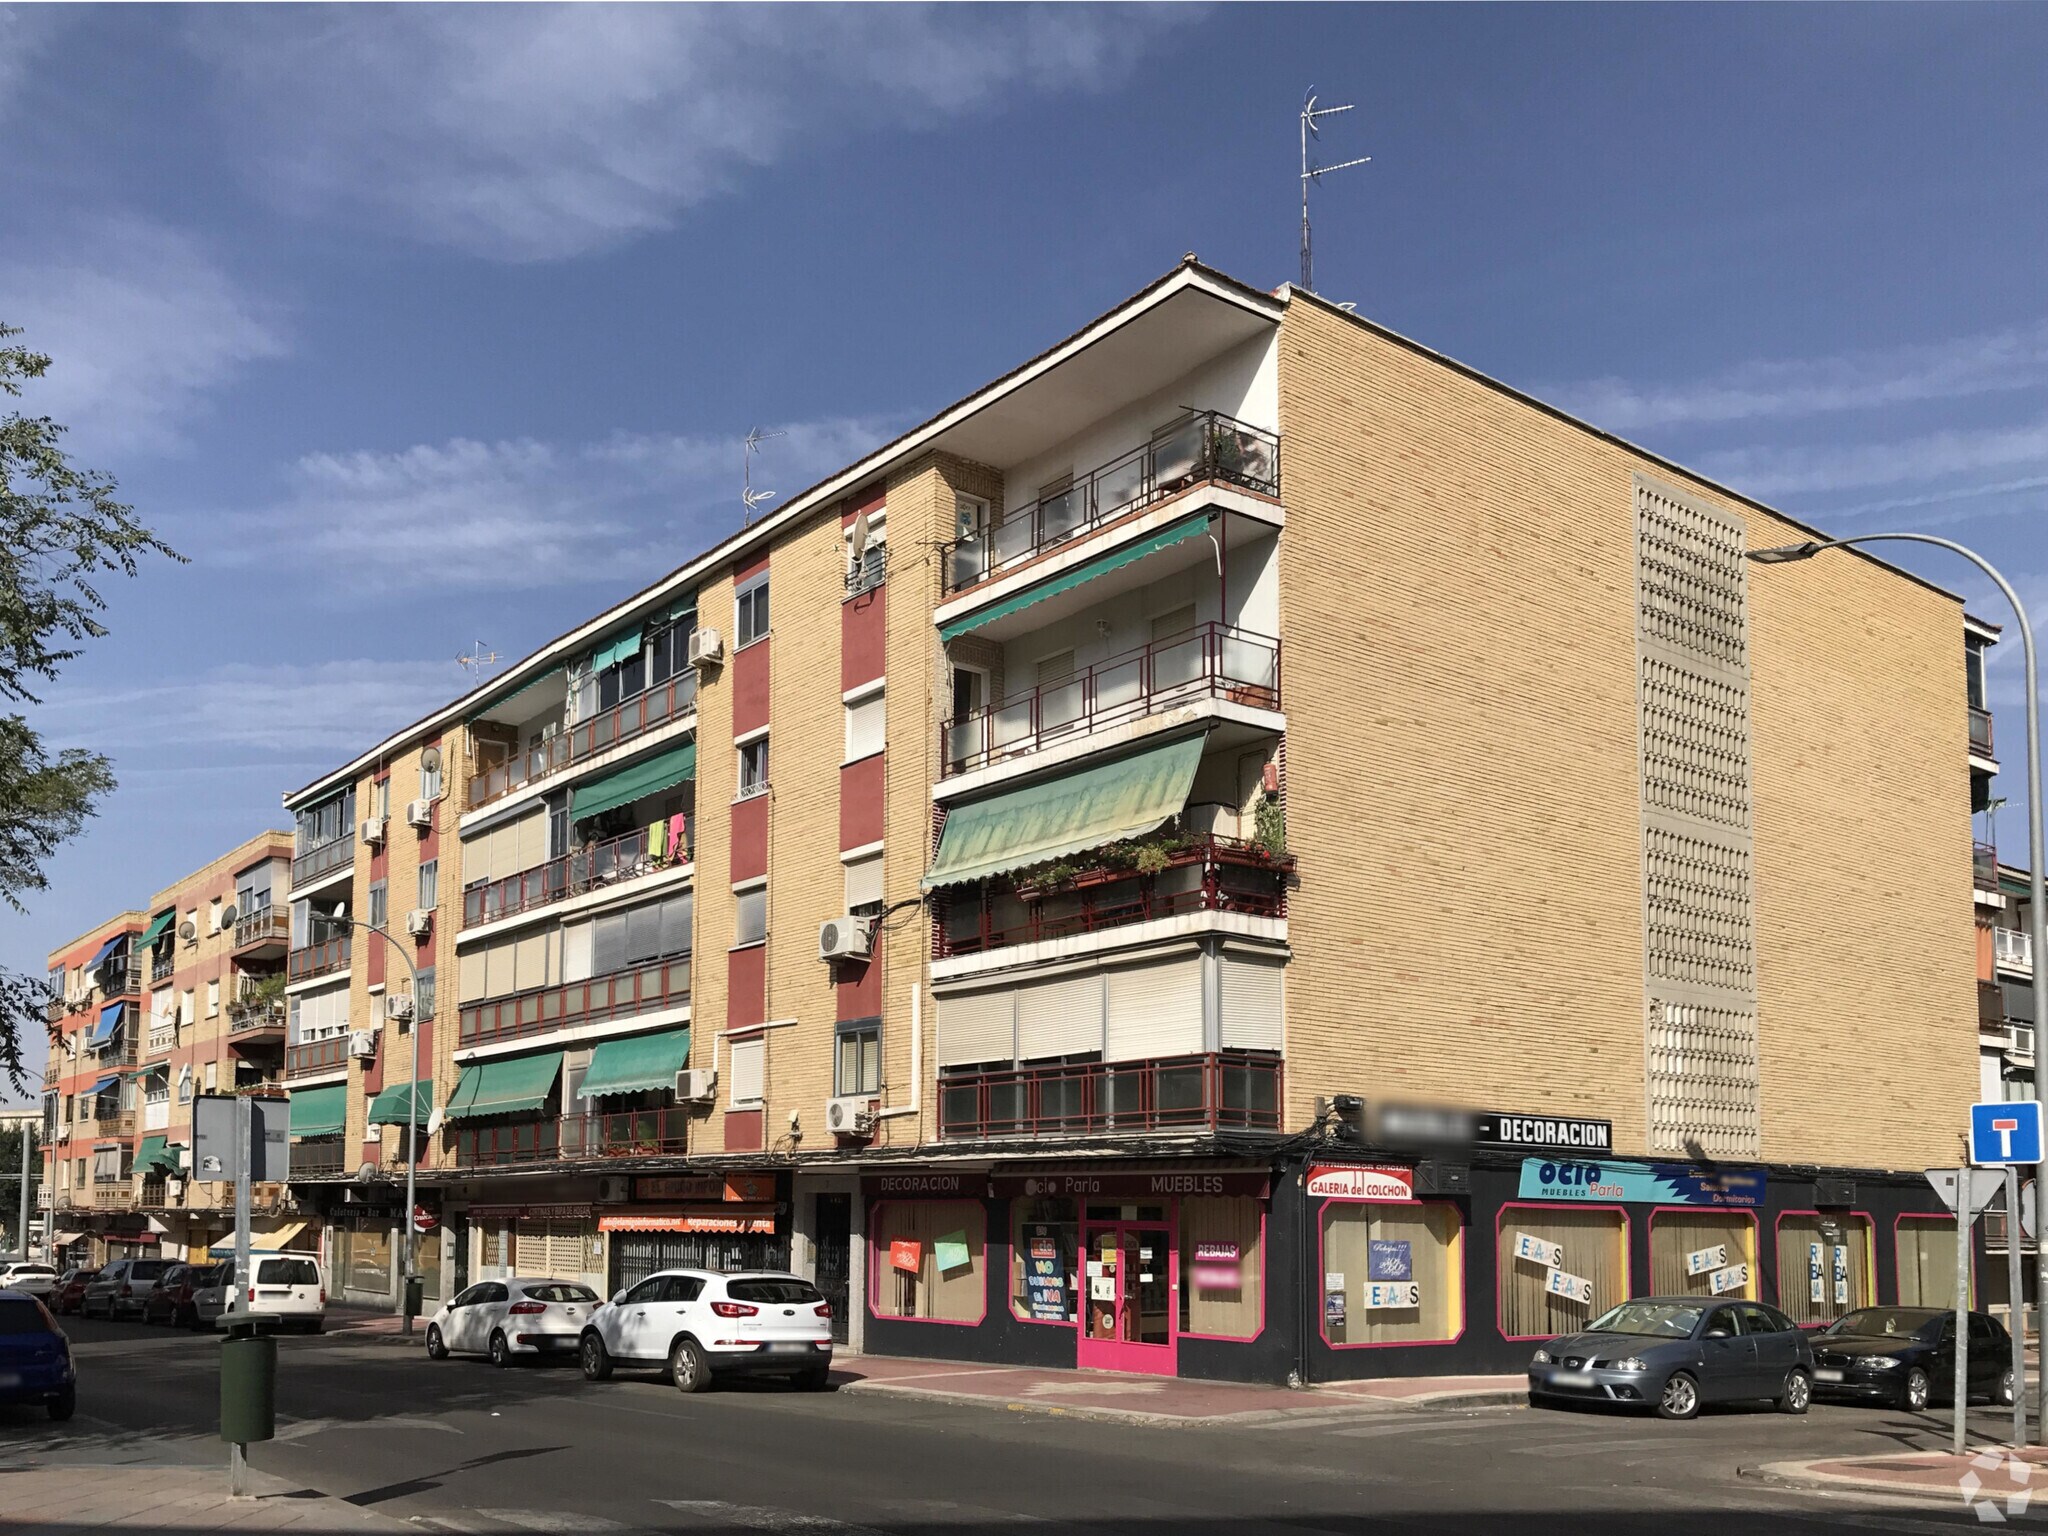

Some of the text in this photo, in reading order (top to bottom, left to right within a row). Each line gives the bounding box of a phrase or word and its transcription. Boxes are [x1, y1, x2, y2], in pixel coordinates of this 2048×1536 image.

[1500, 1118, 1608, 1147] DECORACION
[1310, 1160, 1410, 1172] DISTRIBUIDOR OFICIAL
[1539, 1162, 1602, 1186] OCIO
[881, 1176, 960, 1191] DECORACION
[1065, 1176, 1100, 1193] Parla
[1151, 1176, 1223, 1193] MUEBLES
[1311, 1181, 1349, 1195] GALERIA
[1366, 1184, 1408, 1197] COLCHON
[1589, 1181, 1624, 1197] Parla
[1541, 1187, 1586, 1197] MUEBLES
[687, 1218, 737, 1229] Reparaciones
[1197, 1244, 1236, 1258] REBAJAS
[1035, 1260, 1054, 1275] NO
